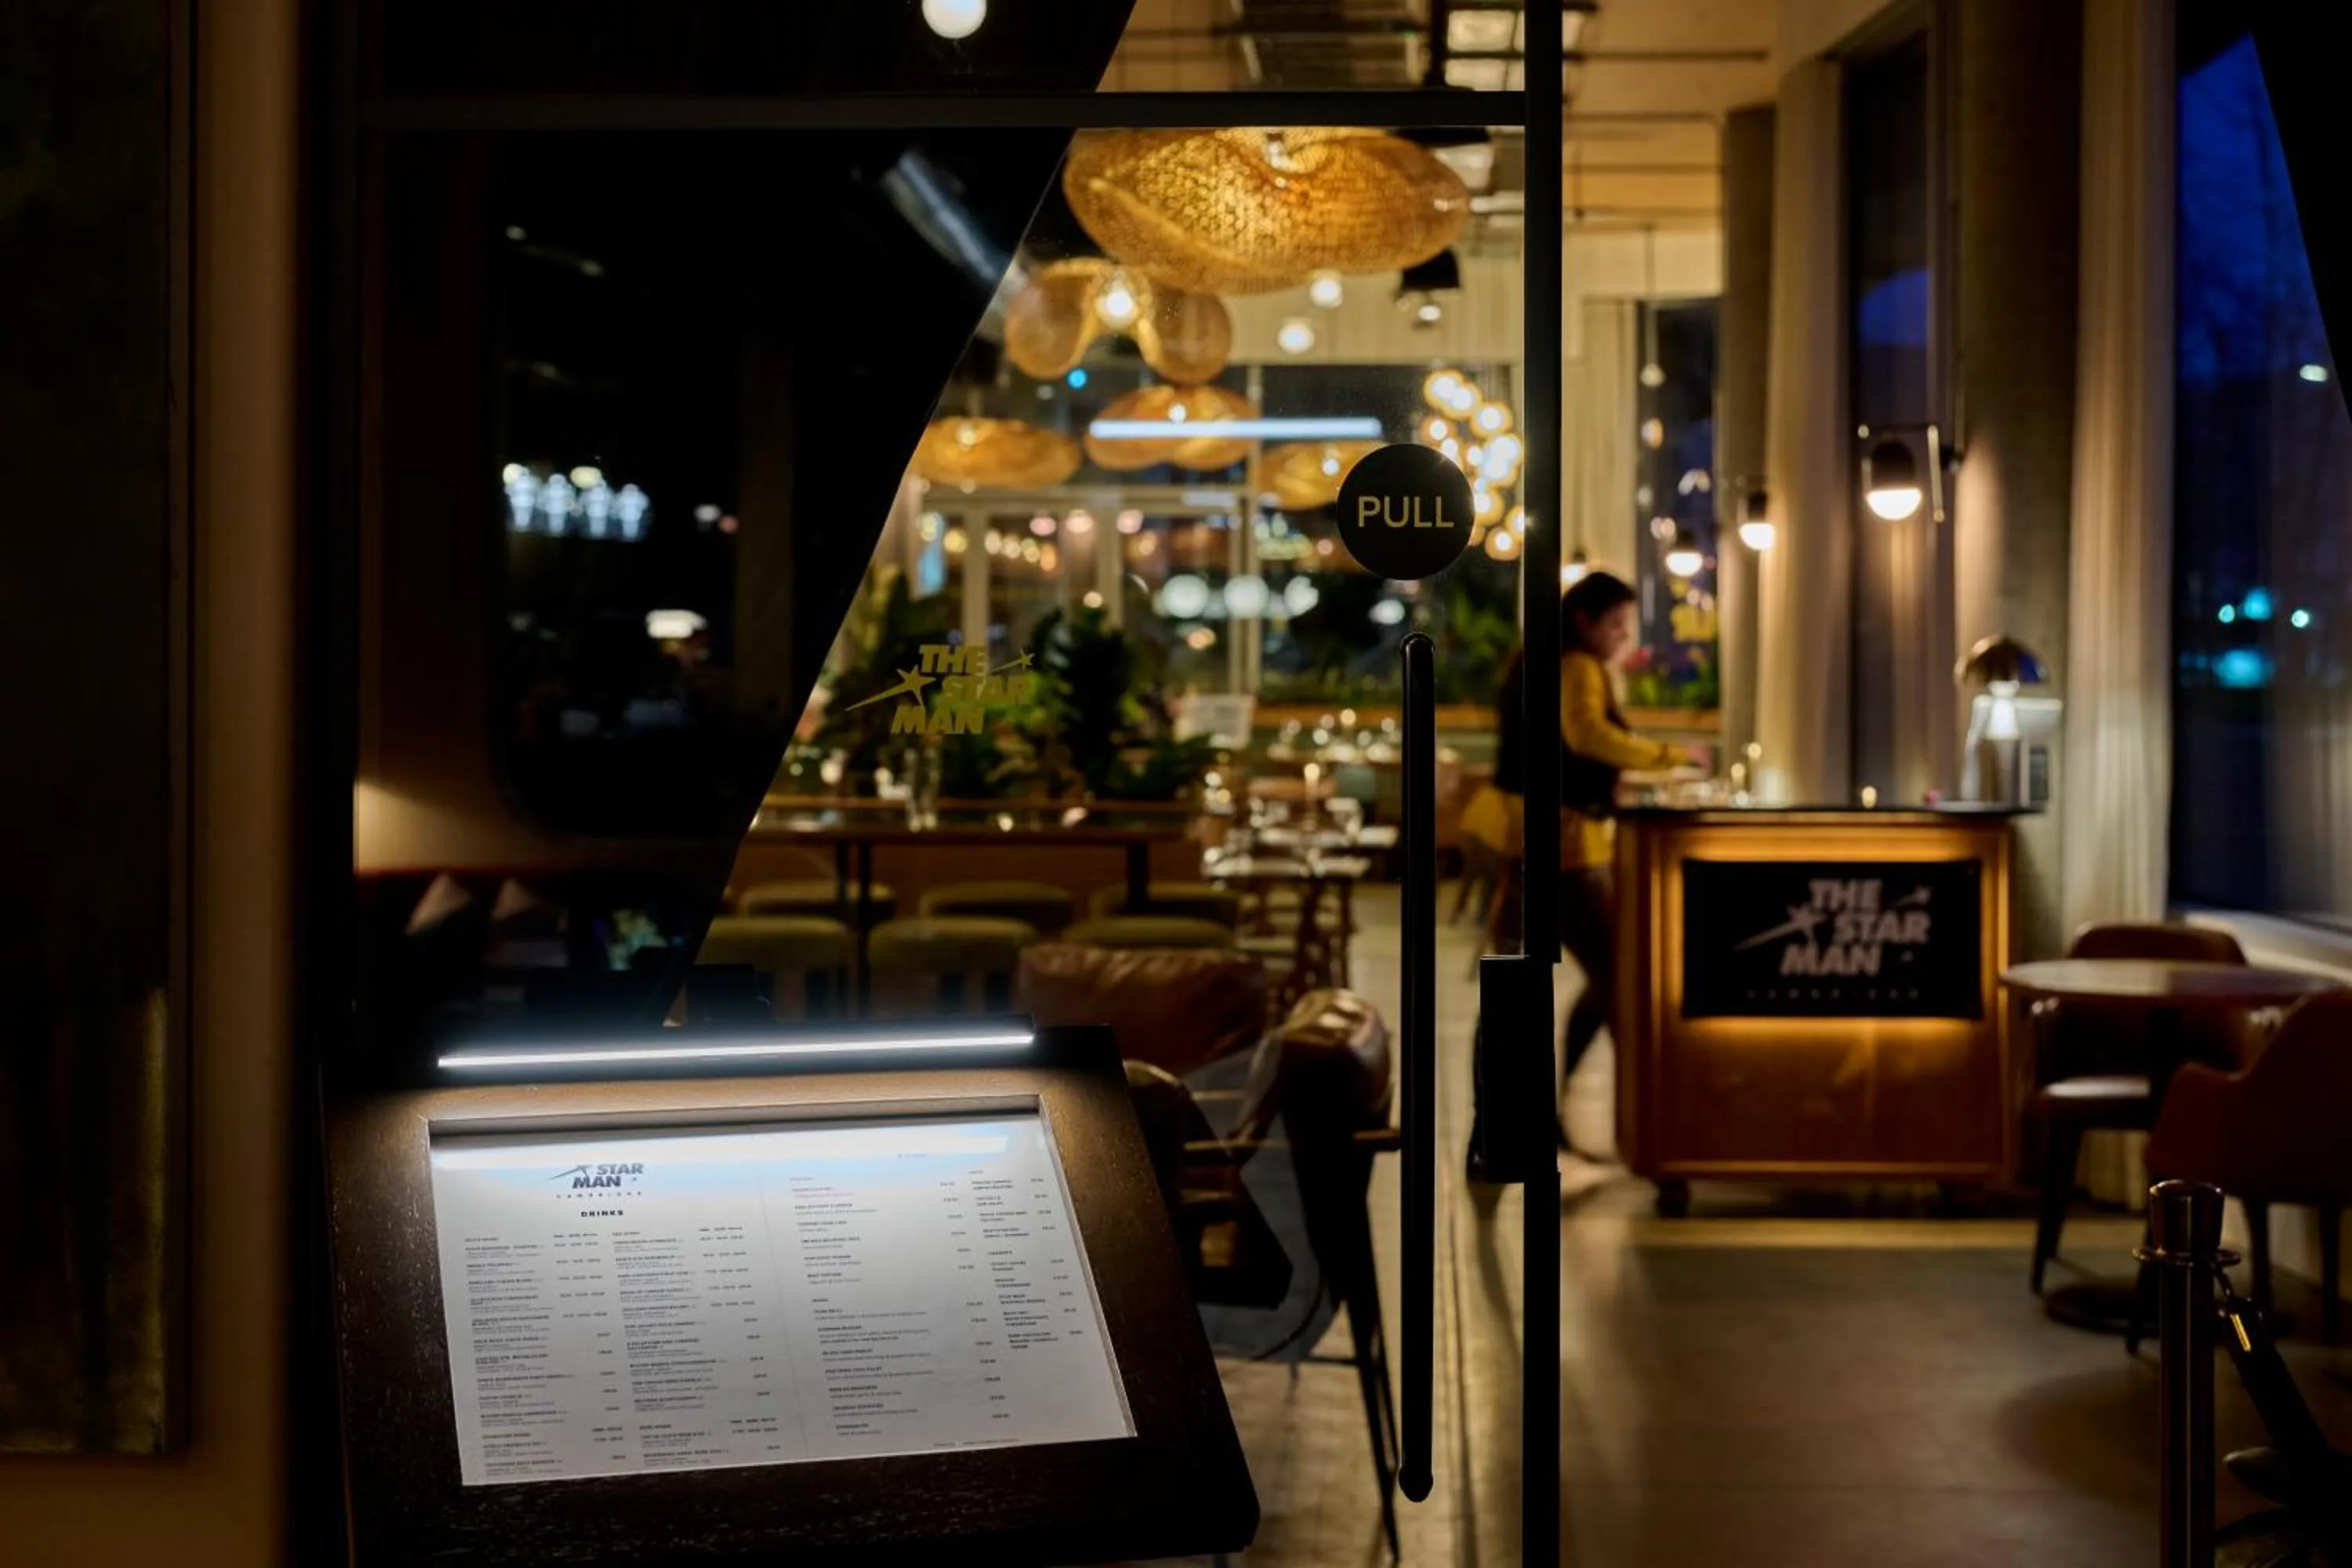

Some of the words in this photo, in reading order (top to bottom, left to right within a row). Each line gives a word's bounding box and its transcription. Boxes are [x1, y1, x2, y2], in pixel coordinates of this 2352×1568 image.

[1358, 495, 1455, 528] PULL
[919, 644, 987, 673] THE
[941, 674, 1031, 705] STAR
[890, 705, 985, 735] MAN
[1808, 878, 1884, 909] THE
[1832, 910, 1932, 944] STAR
[1779, 944, 1882, 976] MAN
[572, 1175, 622, 1189] MAN
[596, 1163, 644, 1175] STAR
